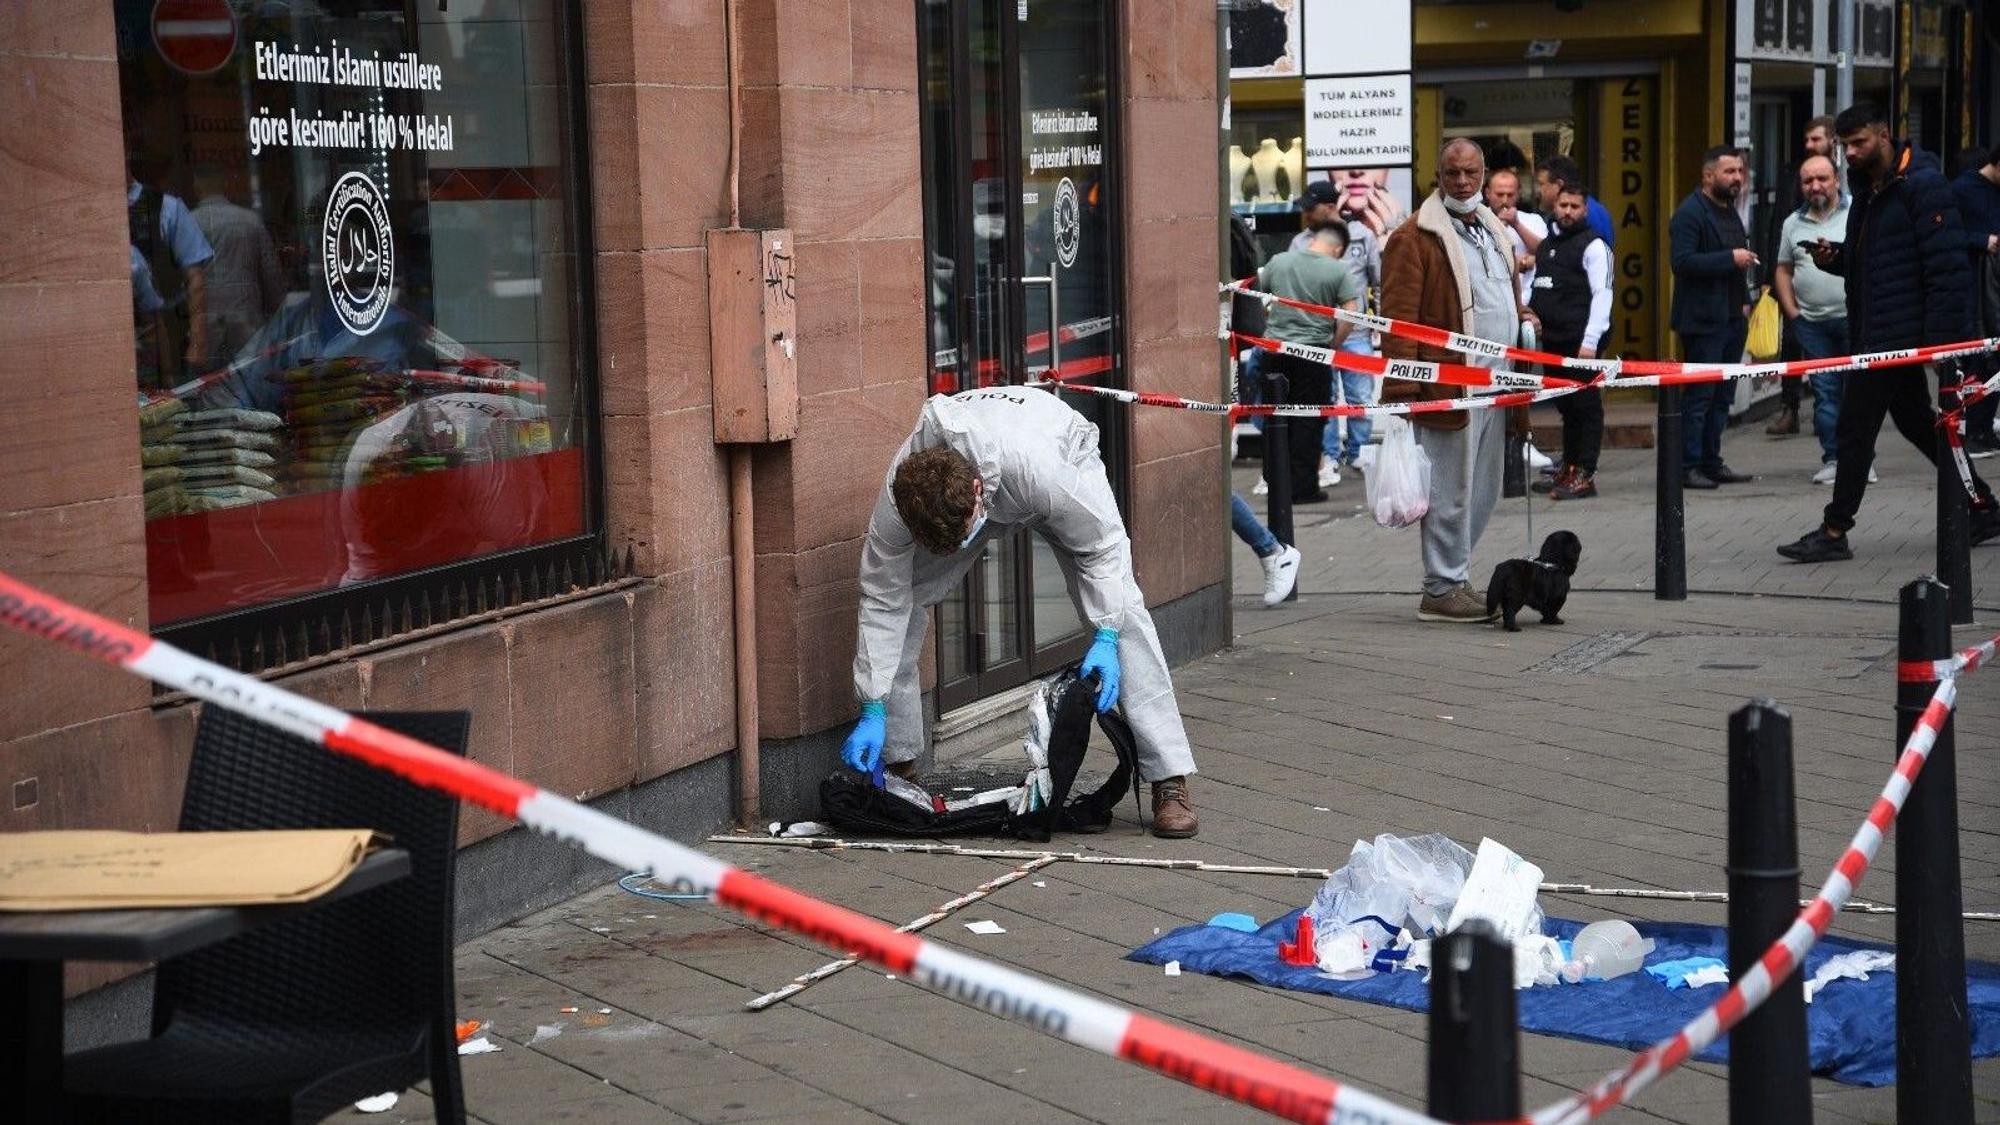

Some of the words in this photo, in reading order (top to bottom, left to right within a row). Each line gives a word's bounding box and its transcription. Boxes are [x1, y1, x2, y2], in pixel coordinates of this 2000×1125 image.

[255, 41, 330, 84] Etlerimiz
[332, 38, 381, 87] İslami
[382, 52, 442, 91] usüllere
[1350, 88, 1396, 99] ALYANS
[250, 106, 288, 155] göre
[290, 107, 366, 149] kesimdir!
[368, 113, 396, 149] 100
[399, 115, 413, 149] %
[415, 114, 454, 151] Helal
[1306, 144, 1411, 157] BULUNMAKTADIR
[1340, 127, 1377, 137] HAZIR
[1622, 78, 1642, 229] ZERDA
[328, 181, 373, 231] Certification
[326, 235, 340, 287] Halal
[371, 199, 392, 280] Authority
[336, 285, 387, 325] International
[1390, 363, 1432, 380] POLIZEI
